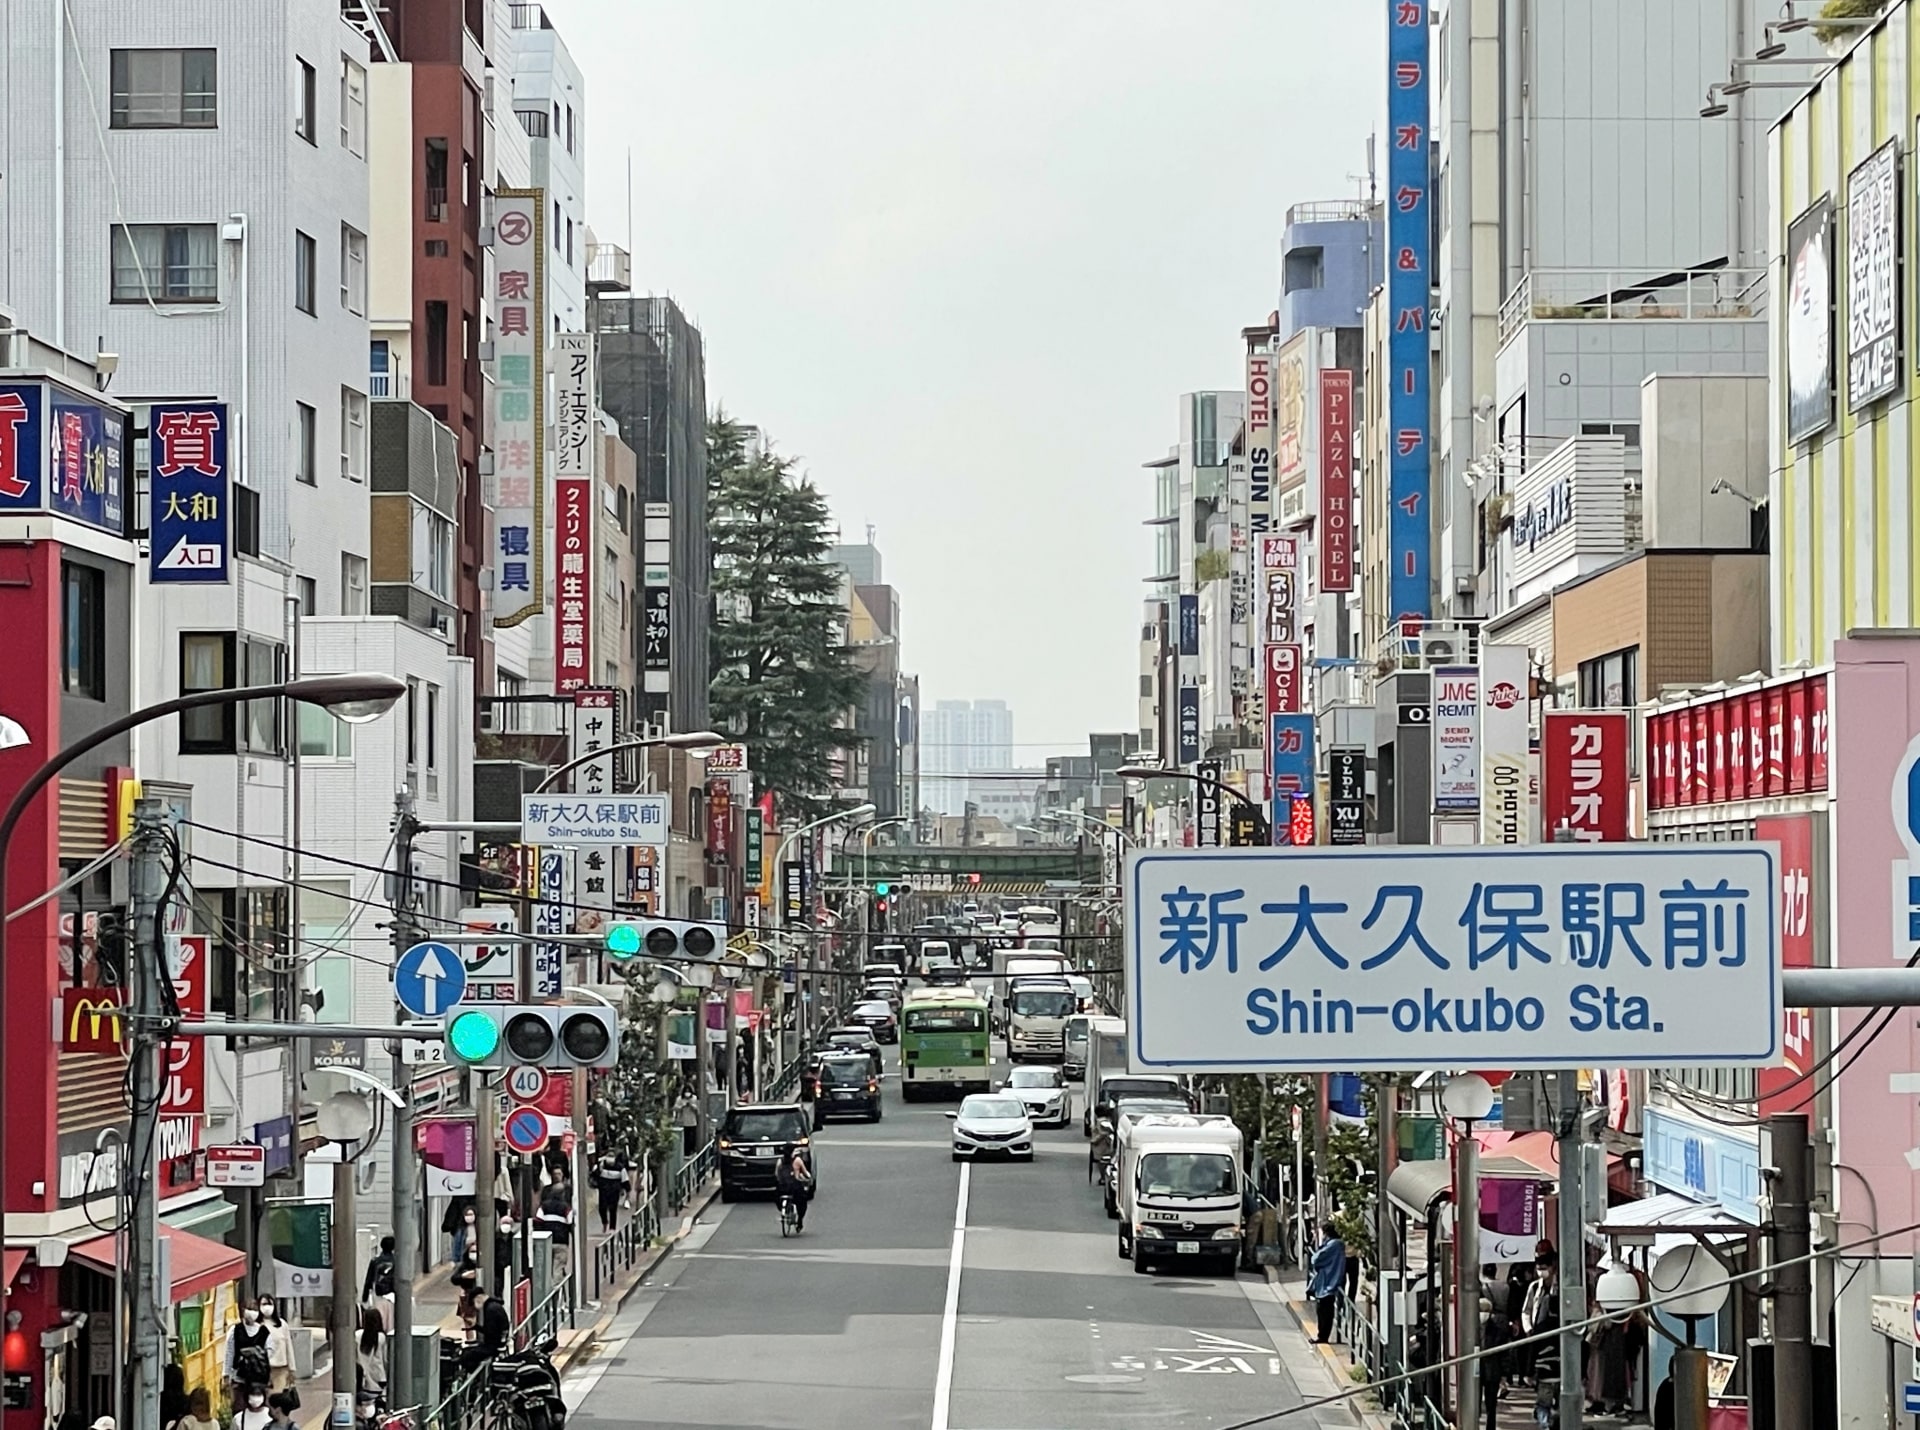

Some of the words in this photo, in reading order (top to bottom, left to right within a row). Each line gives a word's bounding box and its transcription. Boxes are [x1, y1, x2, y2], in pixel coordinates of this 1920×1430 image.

[498, 270, 530, 337] 家具
[560, 338, 586, 349] INC
[1250, 360, 1269, 432] HOTEL
[1323, 378, 1350, 388] TOKYO
[155, 410, 222, 478] 質
[558, 389, 570, 470] エンジニアリング
[1329, 393, 1345, 480] PLAZA
[83, 438, 105, 496] 大和
[1250, 447, 1269, 502] SUN
[160, 491, 218, 523] 大和
[1268, 540, 1292, 553] 24h
[1329, 497, 1345, 583] HOTEL
[177, 548, 214, 566] 入口
[500, 525, 530, 592] 寝具
[1265, 552, 1295, 567] OPEN
[561, 486, 585, 669] クスリの龍生堂薬局
[646, 608, 661, 654] マキバ
[1275, 673, 1292, 711] Caf
[1438, 682, 1477, 701] JME
[1437, 703, 1477, 717] REMIT
[1440, 736, 1475, 744] MONEY
[1444, 727, 1471, 735] SEND
[528, 802, 661, 825] 新大久保駅前
[1336, 807, 1360, 820] XU
[548, 826, 615, 838] Shin-okubo
[620, 827, 641, 838] Sta.
[482, 847, 498, 858] 2F
[549, 874, 561, 974] JBCモイル
[1158, 878, 1750, 975] 新大久保駅前
[1245, 986, 1545, 1036] Shin-okubo
[1568, 984, 1665, 1034] Sta.
[314, 1055, 361, 1067] KOBAN
[515, 1072, 539, 1091] 40
[1523, 1184, 1535, 1212] TOKYO
[319, 1209, 328, 1243] TOKYO
[1523, 1212, 1533, 1234] 2020
